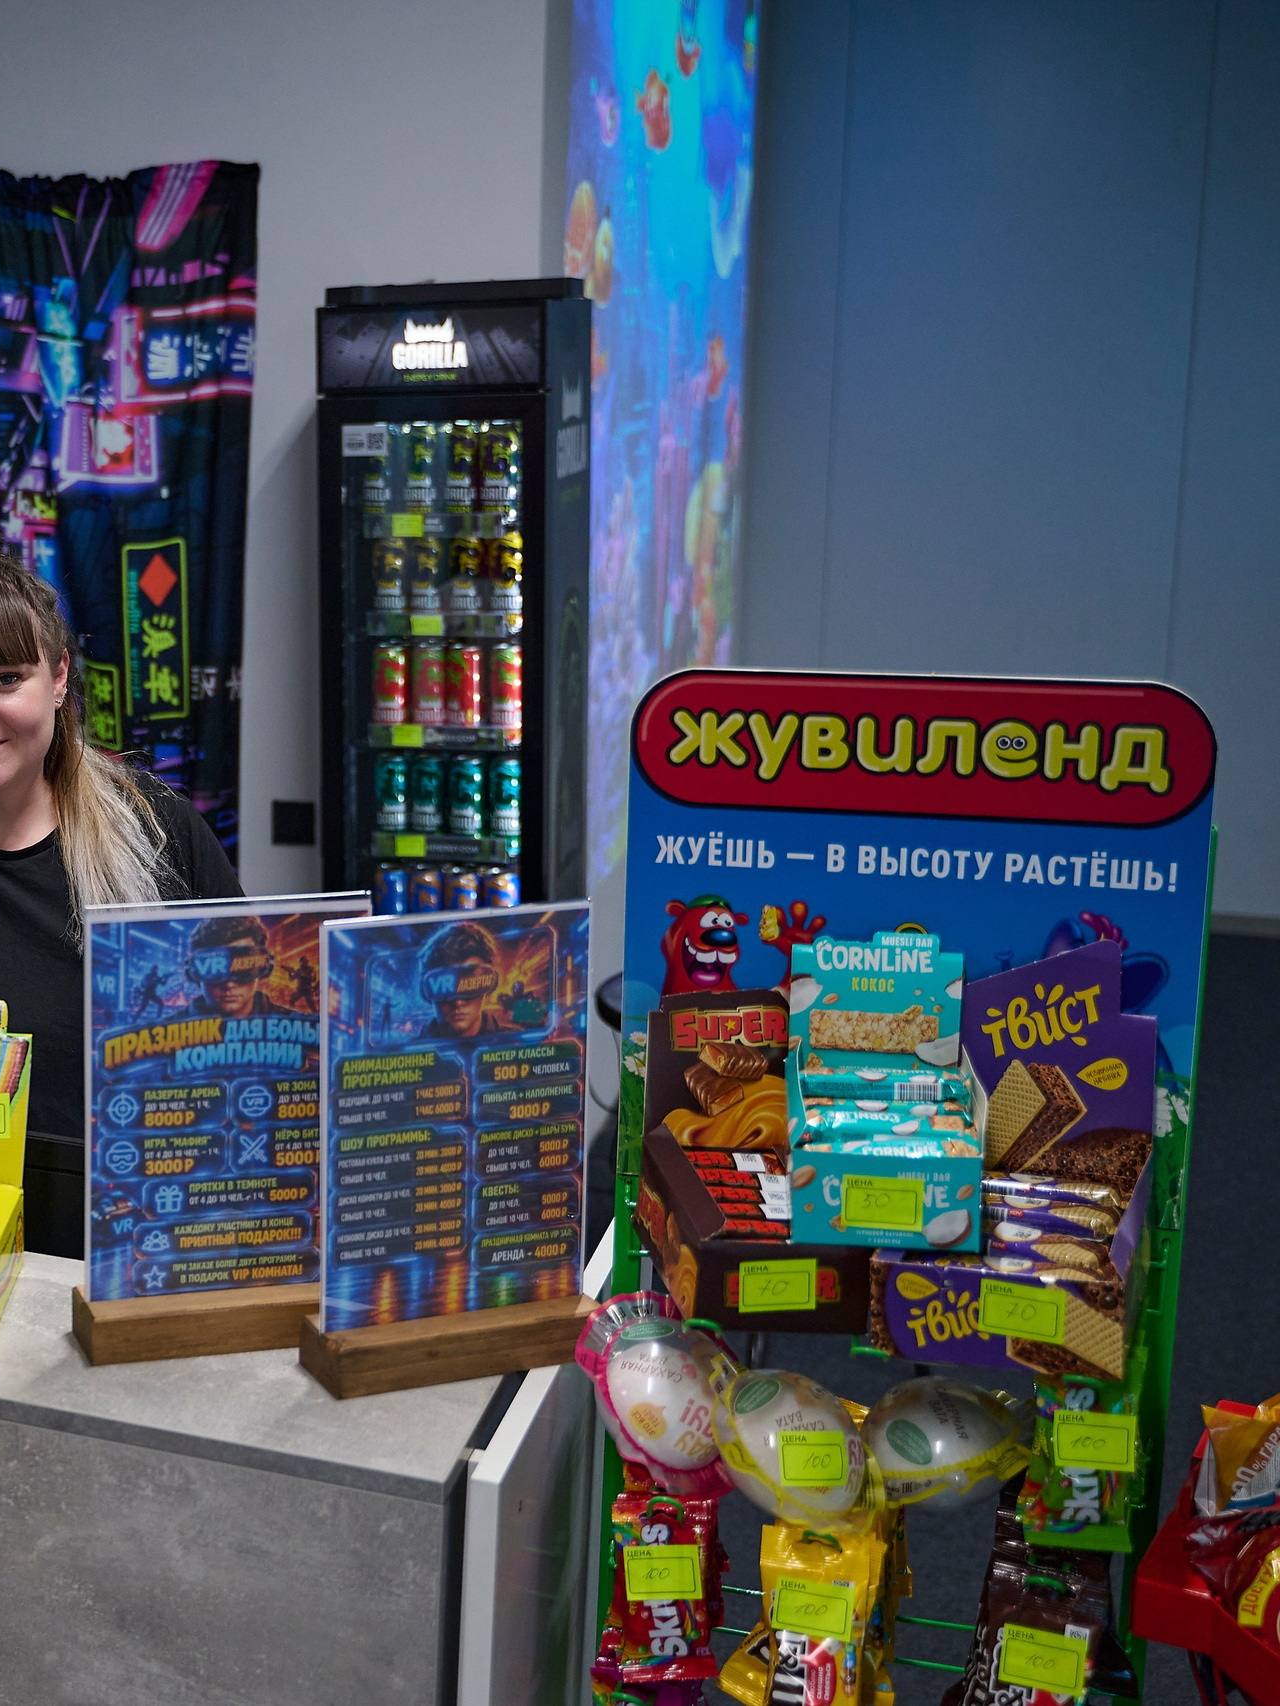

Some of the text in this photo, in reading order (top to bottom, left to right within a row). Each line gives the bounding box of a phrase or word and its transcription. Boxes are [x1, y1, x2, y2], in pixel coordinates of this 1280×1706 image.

[392, 341, 468, 370] GORILLA
[655, 832, 1178, 893] ЖУЁШЬ В ВЫСОТУ РАСТЁШЬ!
[881, 936, 933, 948] MUESLI BAR
[194, 957, 228, 975] VR
[96, 975, 115, 995] VR
[429, 975, 455, 993] VR
[851, 977, 895, 993] КОКОС
[674, 1010, 788, 1048] SUPER
[104, 1018, 319, 1070] ПРАЗДНИК ДЛЯ БОЛЬ
[175, 1042, 302, 1072] КОМПАНИИ
[483, 1046, 555, 1063] МАСТЕР КЛАССЫ
[342, 1053, 435, 1074] АНИМАЦИОННЫЕ
[494, 1062, 570, 1081] 500 ЧЕЛОВЕКА
[276, 1080, 317, 1092] VR ЗОНА
[343, 1069, 423, 1090] ПРОГРАММЫ:
[190, 1087, 221, 1098] АРЕНА
[278, 1095, 290, 1104] ДО
[483, 1084, 573, 1104] ПИНЬЯТА НАПОЛНЕНИЕ
[278, 1102, 316, 1119] 8000
[509, 1103, 540, 1119] 3000
[145, 1111, 183, 1127] 8000
[275, 1129, 300, 1141] НЁРФ
[340, 1131, 431, 1152] ШОУ ПРОГРАММЫ:
[144, 1138, 166, 1149] ИГРА
[539, 1140, 561, 1152] 5000
[276, 1150, 314, 1166] 5000
[488, 1148, 498, 1158] ДО
[145, 1159, 183, 1175] 3000
[485, 1163, 508, 1173] СВЫШЕ
[539, 1155, 561, 1167] 6000
[189, 1177, 277, 1193] ПРЯТКИ В ТЕМНОТЕ
[847, 1179, 873, 1187] ЦЕНА
[933, 1173, 951, 1182] BAR
[269, 1188, 299, 1202] 5000
[482, 1184, 520, 1197] КВЕСТЫ:
[541, 1193, 561, 1205] 5000
[861, 1193, 890, 1208] 50
[541, 1208, 561, 1219] 6000
[114, 1218, 132, 1235] VR
[174, 1217, 294, 1235] КАЖДОМУ УЧАСТНИКУ В КОНЦЕ
[180, 1227, 302, 1248] ПРИЯТНЫЙ ПОДАРОК!!!
[491, 1249, 524, 1262] АРЕНДА
[534, 1244, 559, 1258] 4000
[215, 1259, 237, 1268] БОЛЕЕ
[258, 1255, 297, 1265] ПРОГРАММ
[743, 1265, 768, 1273] ЦЕНА
[180, 1264, 303, 1283] В ПОДАРОК VIP КОМНАТА!
[758, 1280, 789, 1296] 70
[985, 1284, 1012, 1294] ЦЕНА
[1006, 1303, 1036, 1320] 70
[639, 1353, 669, 1365] ВАТА
[620, 1359, 683, 1383] САХАРНАЯ
[775, 1410, 803, 1427] ВАТА
[1059, 1414, 1084, 1423] ЦЕНА
[642, 1423, 656, 1437] ЭТО
[782, 1435, 807, 1443] ЦЕНА
[1071, 1437, 1105, 1449] 100
[803, 1452, 832, 1470] 100
[627, 1550, 651, 1558] ЦЕНА
[642, 1568, 669, 1579] 100
[781, 1579, 806, 1590] ЦЕНА
[794, 1602, 828, 1616] 100
[1008, 1629, 1035, 1640] ЦЕНА
[1025, 1653, 1055, 1669] 100
